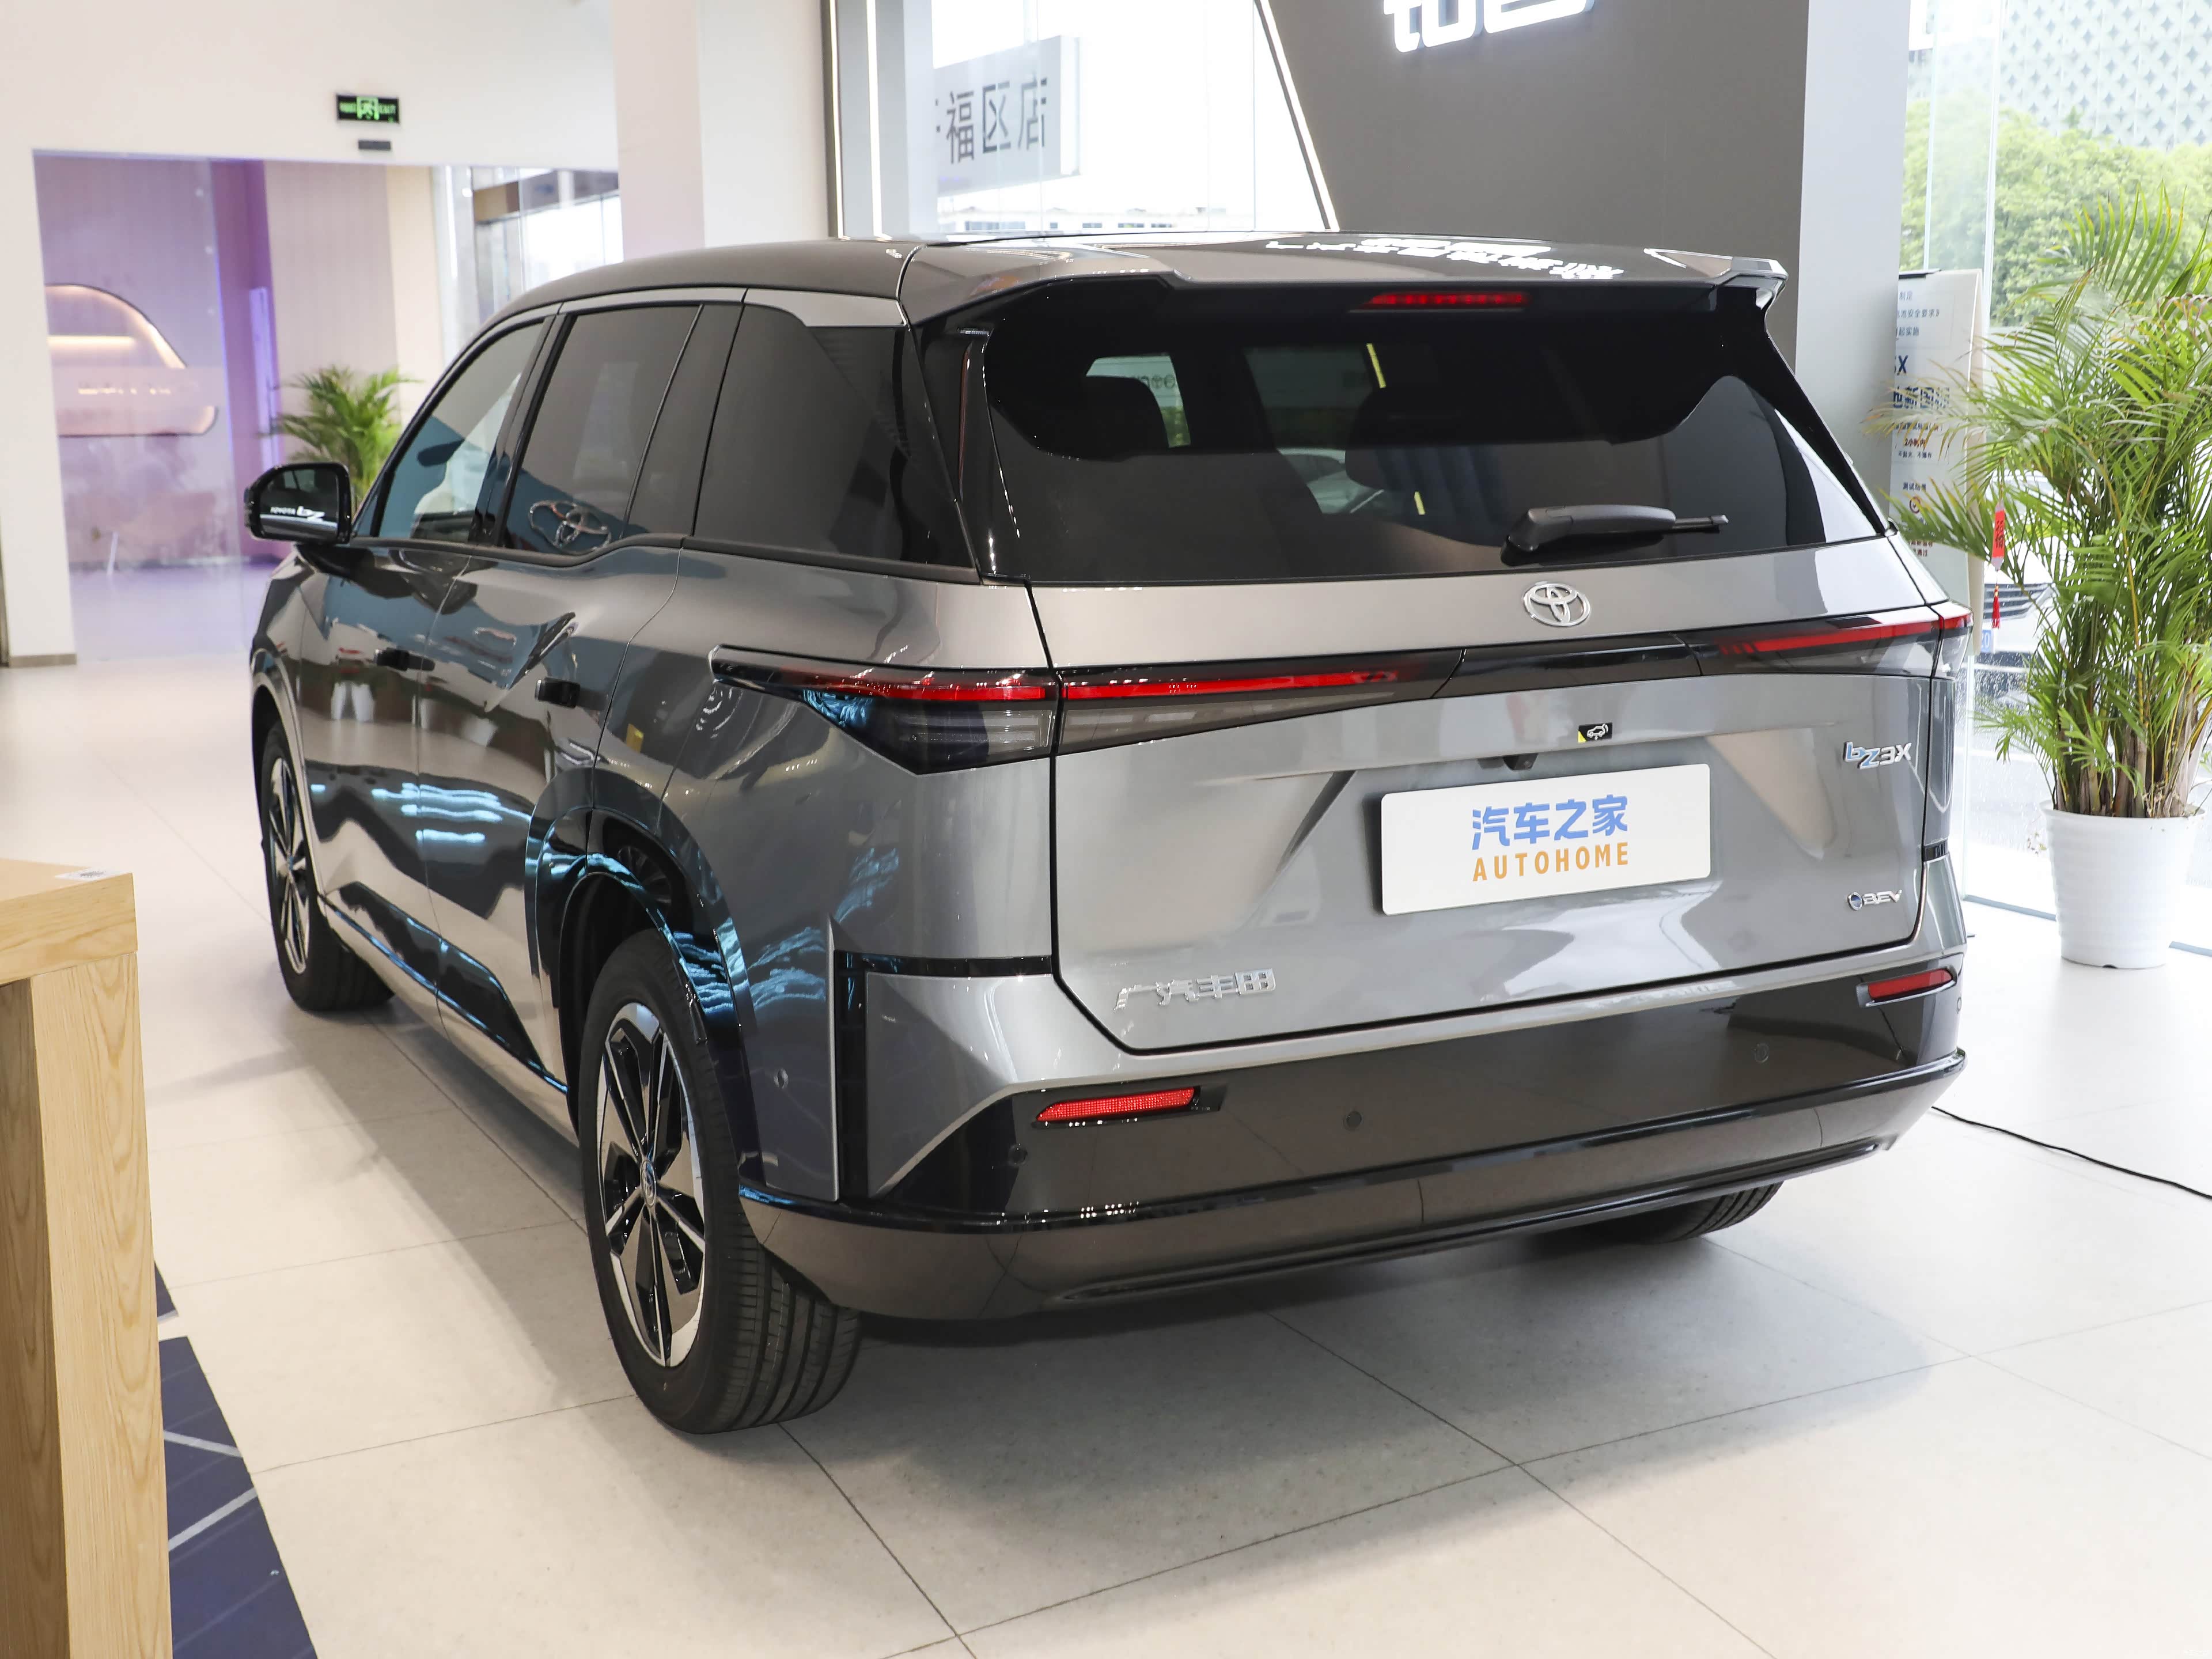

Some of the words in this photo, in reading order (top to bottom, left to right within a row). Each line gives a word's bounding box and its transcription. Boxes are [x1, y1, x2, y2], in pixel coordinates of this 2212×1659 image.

[935, 74, 1047, 164] 福区店
[1898, 308, 1940, 318] 池安全要求》
[1896, 327, 1919, 336] 起实施
[1894, 354, 1908, 376] X
[1471, 794, 1628, 851] 汽车之家
[1472, 842, 1628, 882] AUTOHOME
[1862, 889, 1902, 906] BEV
[1113, 968, 1277, 1013] 广汽丰田
